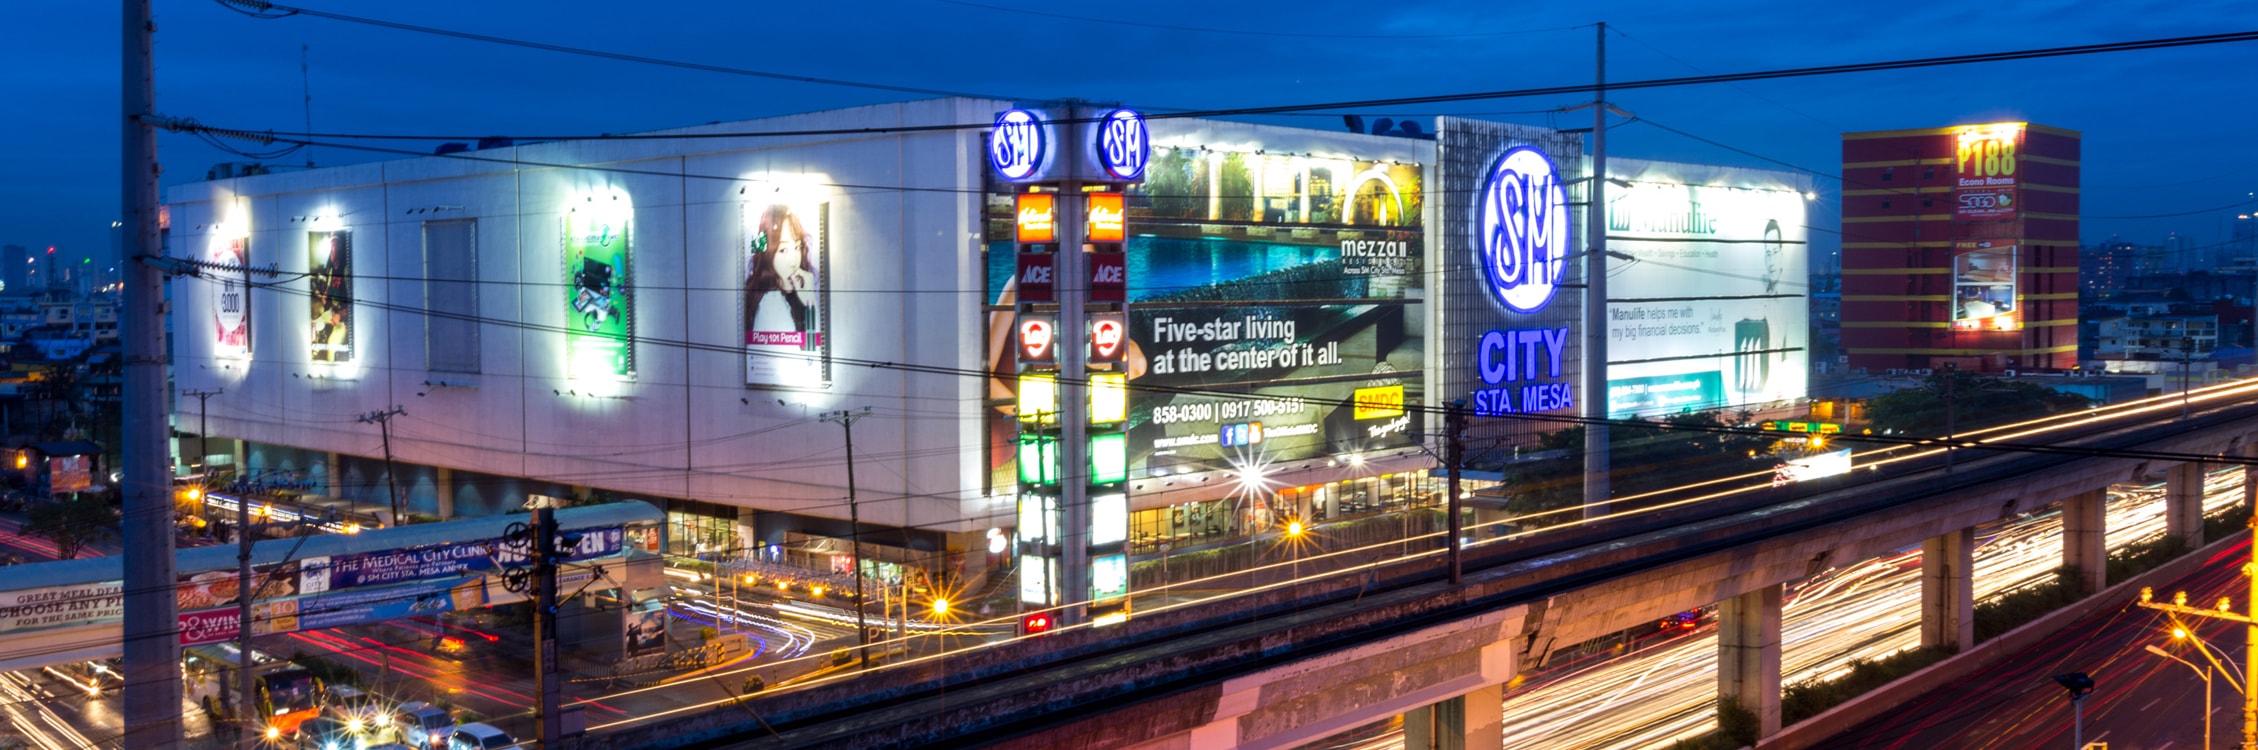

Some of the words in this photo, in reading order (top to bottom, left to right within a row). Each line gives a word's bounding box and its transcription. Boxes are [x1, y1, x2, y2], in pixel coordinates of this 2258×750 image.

[1959, 177, 1984, 187] Econo
[1986, 176, 2015, 185] Rooms
[1958, 192, 1997, 209] SOGO
[1492, 168, 1555, 291] SM
[1341, 239, 1397, 258] mezza
[1021, 264, 1052, 284] ACE
[1093, 263, 1123, 283] ACE
[1646, 306, 1667, 323] helps
[1667, 309, 1679, 319] me
[1680, 305, 1694, 319] with
[753, 332, 768, 345] Play
[769, 333, 780, 343] 101
[780, 332, 803, 344] Pencil
[1153, 316, 1241, 343] Five-star
[1245, 314, 1296, 344] living
[1611, 328, 1624, 342] my
[1625, 324, 1637, 341] big
[1638, 323, 1668, 337] financial
[1153, 350, 1175, 375] at
[1178, 347, 1212, 373] the
[1215, 344, 1275, 371] center
[1278, 343, 1299, 369] of
[1301, 342, 1314, 366] it
[1317, 341, 1343, 366] all.
[1479, 327, 1568, 385] CITY
[1359, 391, 1400, 413] SMDC
[1474, 388, 1518, 416] STA.
[1522, 382, 1574, 414] MESA
[1152, 402, 1212, 424] 858-0300
[1221, 401, 1252, 420] 0917
[1252, 397, 1306, 417] 500-5151
[1153, 433, 1219, 449] www.smdc.com
[367, 573, 380, 582] SM
[381, 571, 399, 581] CITY
[401, 569, 417, 579] STA.
[419, 567, 441, 577] MESA
[372, 566, 392, 574] Where
[394, 563, 419, 571] Patients
[431, 559, 456, 568] Partners
[17, 591, 57, 604] GREAT
[60, 588, 94, 601] MEAL
[0, 601, 64, 619] CHOOSE
[68, 598, 101, 611] ANY
[16, 618, 39, 626] FOR
[41, 614, 63, 624] THE
[65, 610, 94, 621] SAME
[97, 608, 122, 617] PRIC
[868, 626, 881, 645] P
